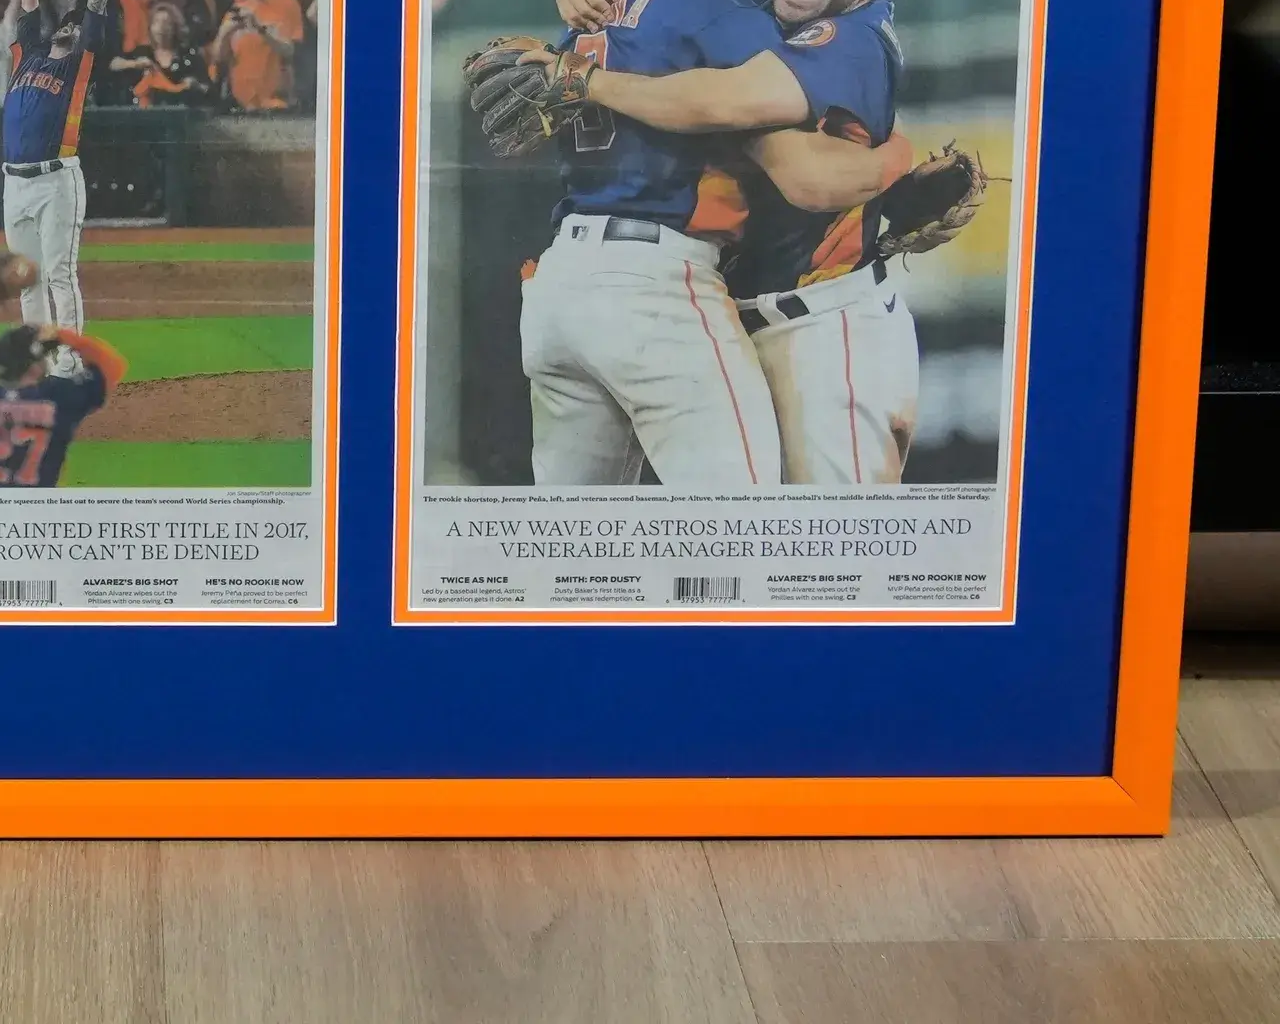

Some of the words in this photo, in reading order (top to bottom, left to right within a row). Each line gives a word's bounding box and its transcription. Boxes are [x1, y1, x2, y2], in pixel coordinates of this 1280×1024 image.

[47, 497, 58, 505] the
[60, 497, 72, 505] last
[122, 497, 133, 505] the
[159, 497, 183, 505] second
[186, 497, 207, 505] World
[209, 497, 231, 505] Series
[233, 497, 285, 506] championship.
[98, 523, 160, 538] FIRST
[166, 522, 229, 538] TITLE
[235, 523, 258, 538] IN
[264, 523, 308, 540] 2017,
[446, 522, 462, 536] A
[468, 521, 521, 537] NEW
[527, 521, 592, 536] WAVE
[598, 520, 626, 536] OF
[631, 520, 717, 536] ASTROS
[723, 519, 802, 535] MAKES
[808, 519, 917, 535] HOUSTON
[922, 519, 971, 534] AND
[69, 544, 136, 560] CAN'T
[142, 544, 168, 560] BE
[174, 544, 259, 560] DENIED
[500, 542, 634, 558] VENERABLE
[640, 541, 754, 557] MANAGER
[760, 541, 834, 556] BAKER
[840, 541, 916, 556] PROUD
[135, 578, 151, 586] BIG
[153, 578, 178, 586] SHOT
[441, 576, 470, 584] TWICE
[472, 576, 484, 584] AS
[487, 576, 508, 584] NICE
[555, 575, 587, 584] SMITH:
[590, 575, 608, 583] FOR
[610, 575, 641, 583] DUSTY
[819, 574, 834, 583] BIG
[837, 574, 862, 582] SHOT
[912, 574, 925, 582] NO
[928, 573, 962, 582] ROOKIE
[965, 573, 986, 582] NOW
[229, 578, 242, 586] NO
[245, 578, 279, 587] ROOKIE
[282, 578, 304, 586] NOW
